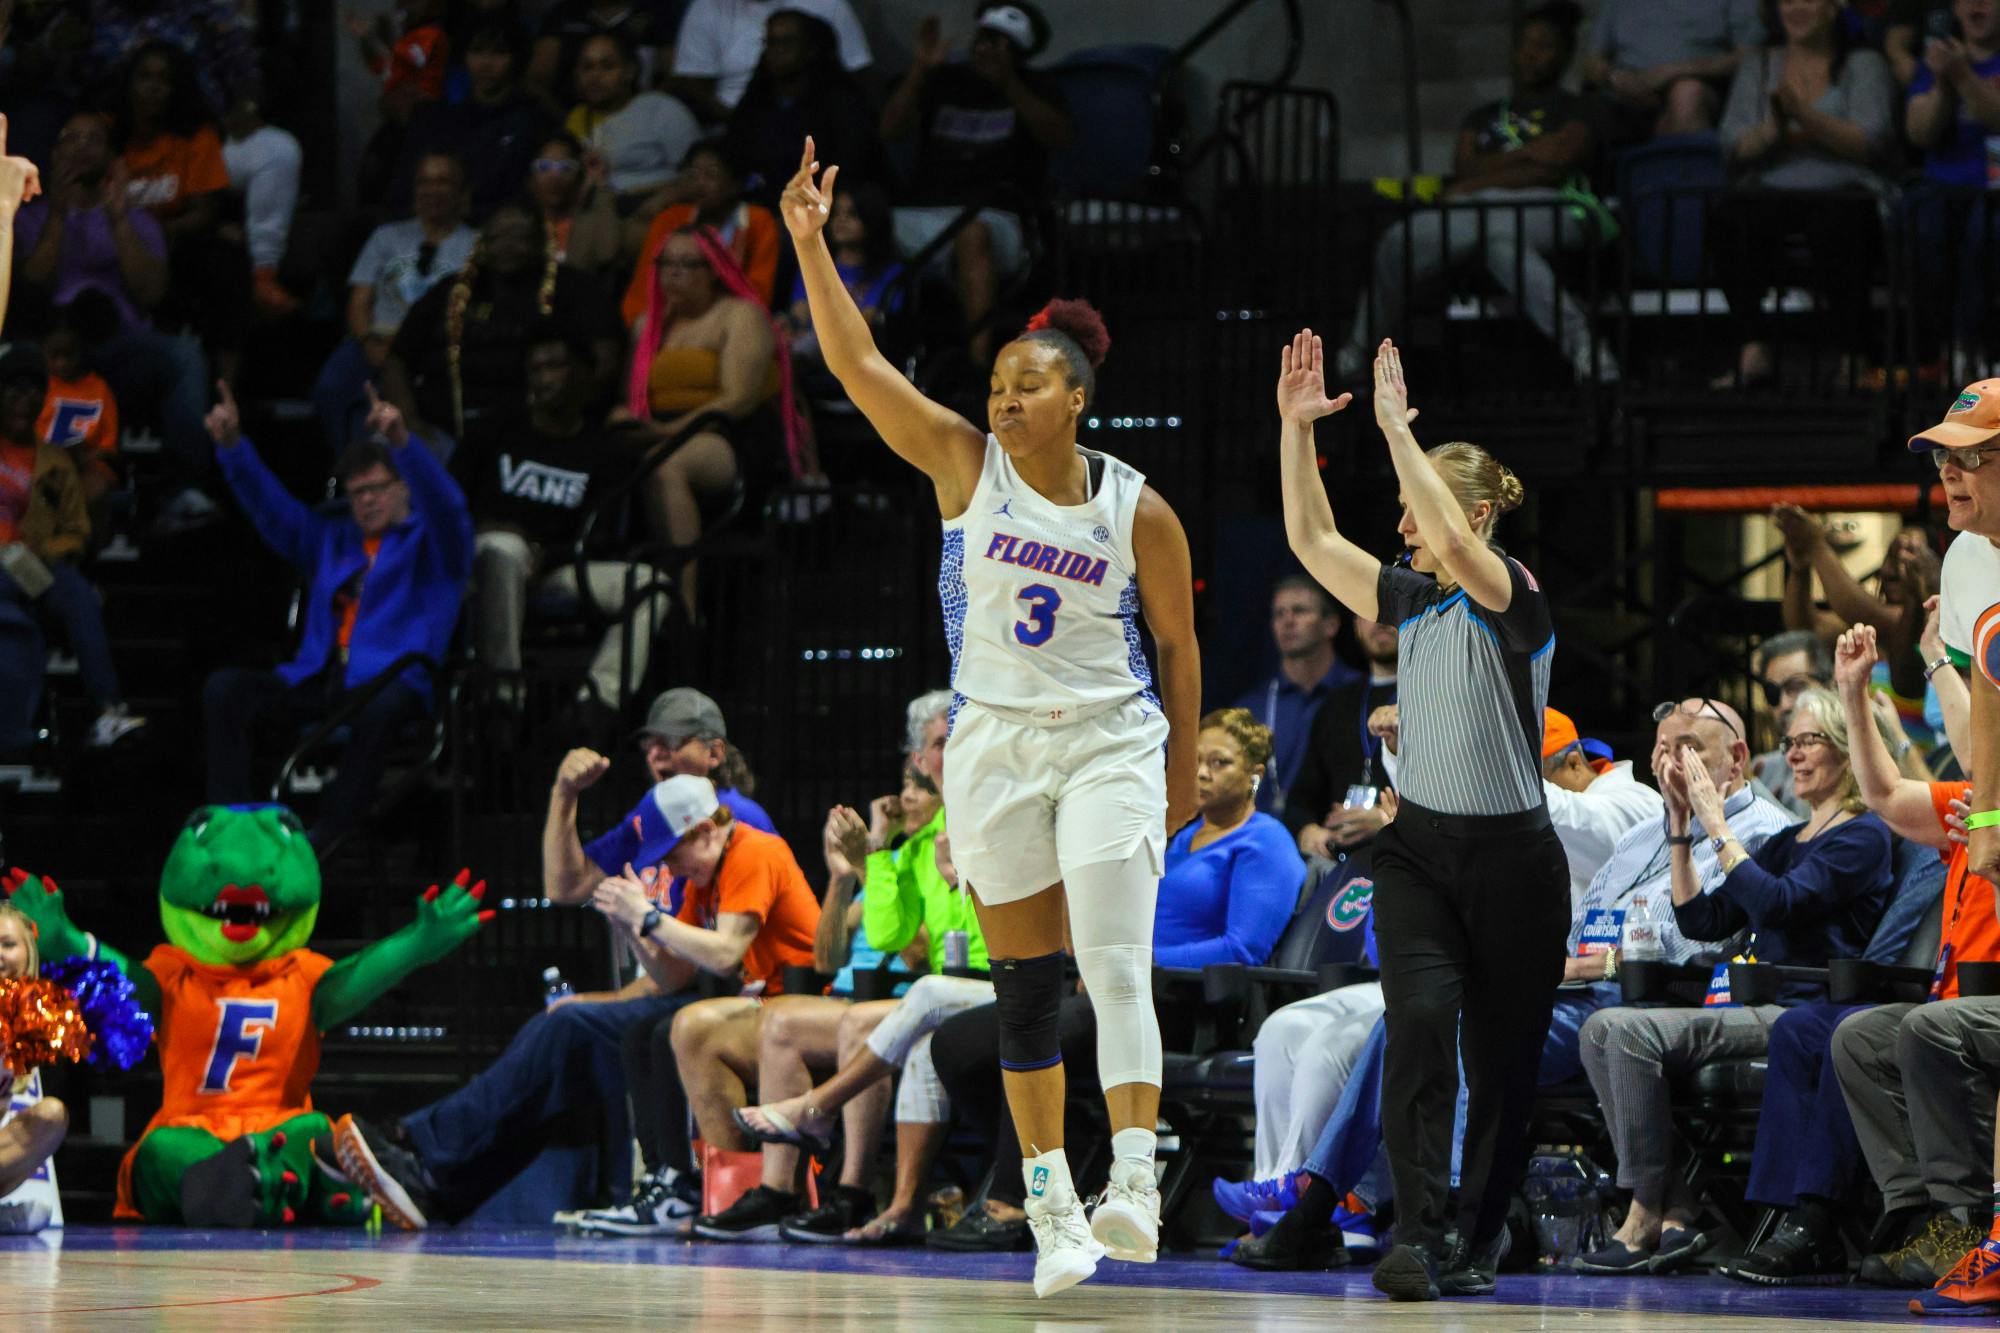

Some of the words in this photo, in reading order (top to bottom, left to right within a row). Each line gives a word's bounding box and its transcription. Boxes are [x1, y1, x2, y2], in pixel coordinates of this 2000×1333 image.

[499, 453, 590, 509] VANS
[984, 532, 1109, 587] FLORIDA
[1014, 583, 1063, 648] 3
[1583, 923, 1621, 938] COURTSIDE
[195, 997, 280, 1094] F
